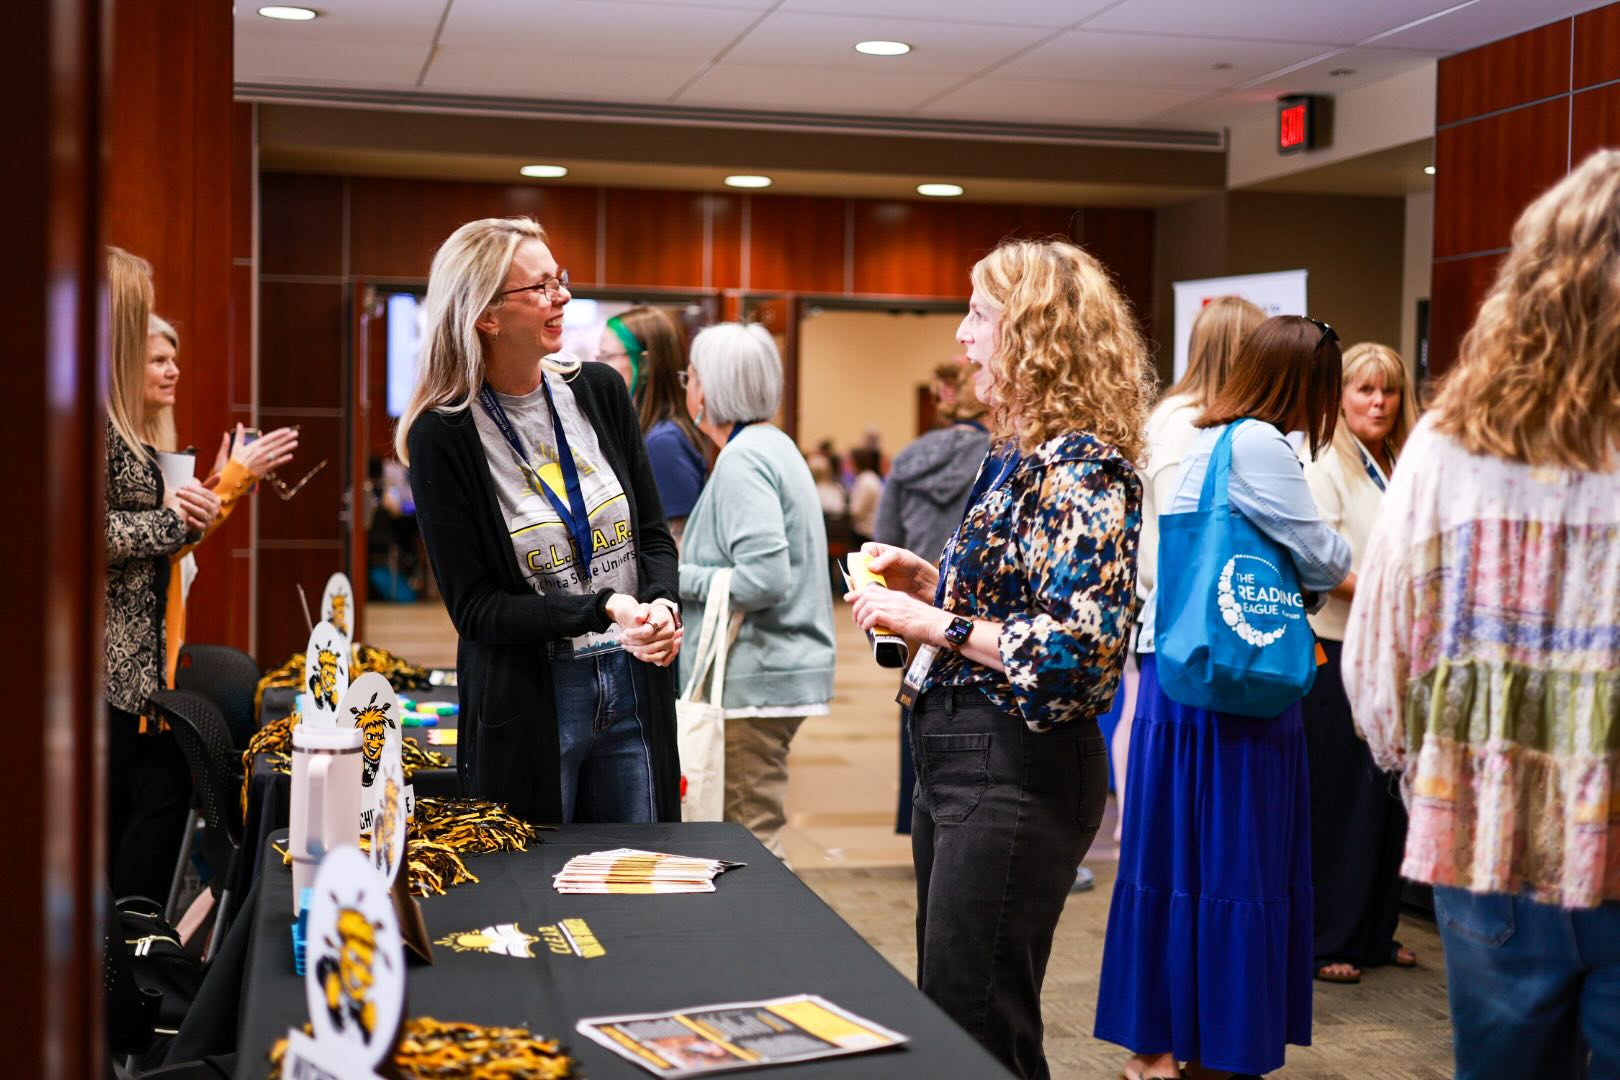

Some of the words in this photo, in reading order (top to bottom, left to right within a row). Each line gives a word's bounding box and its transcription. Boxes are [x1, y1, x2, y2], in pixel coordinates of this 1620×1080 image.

[527, 519, 634, 572] C.L.A.R.
[1236, 573, 1255, 584] THE
[1237, 585, 1304, 607] READING
[1242, 602, 1279, 616] EAGUE
